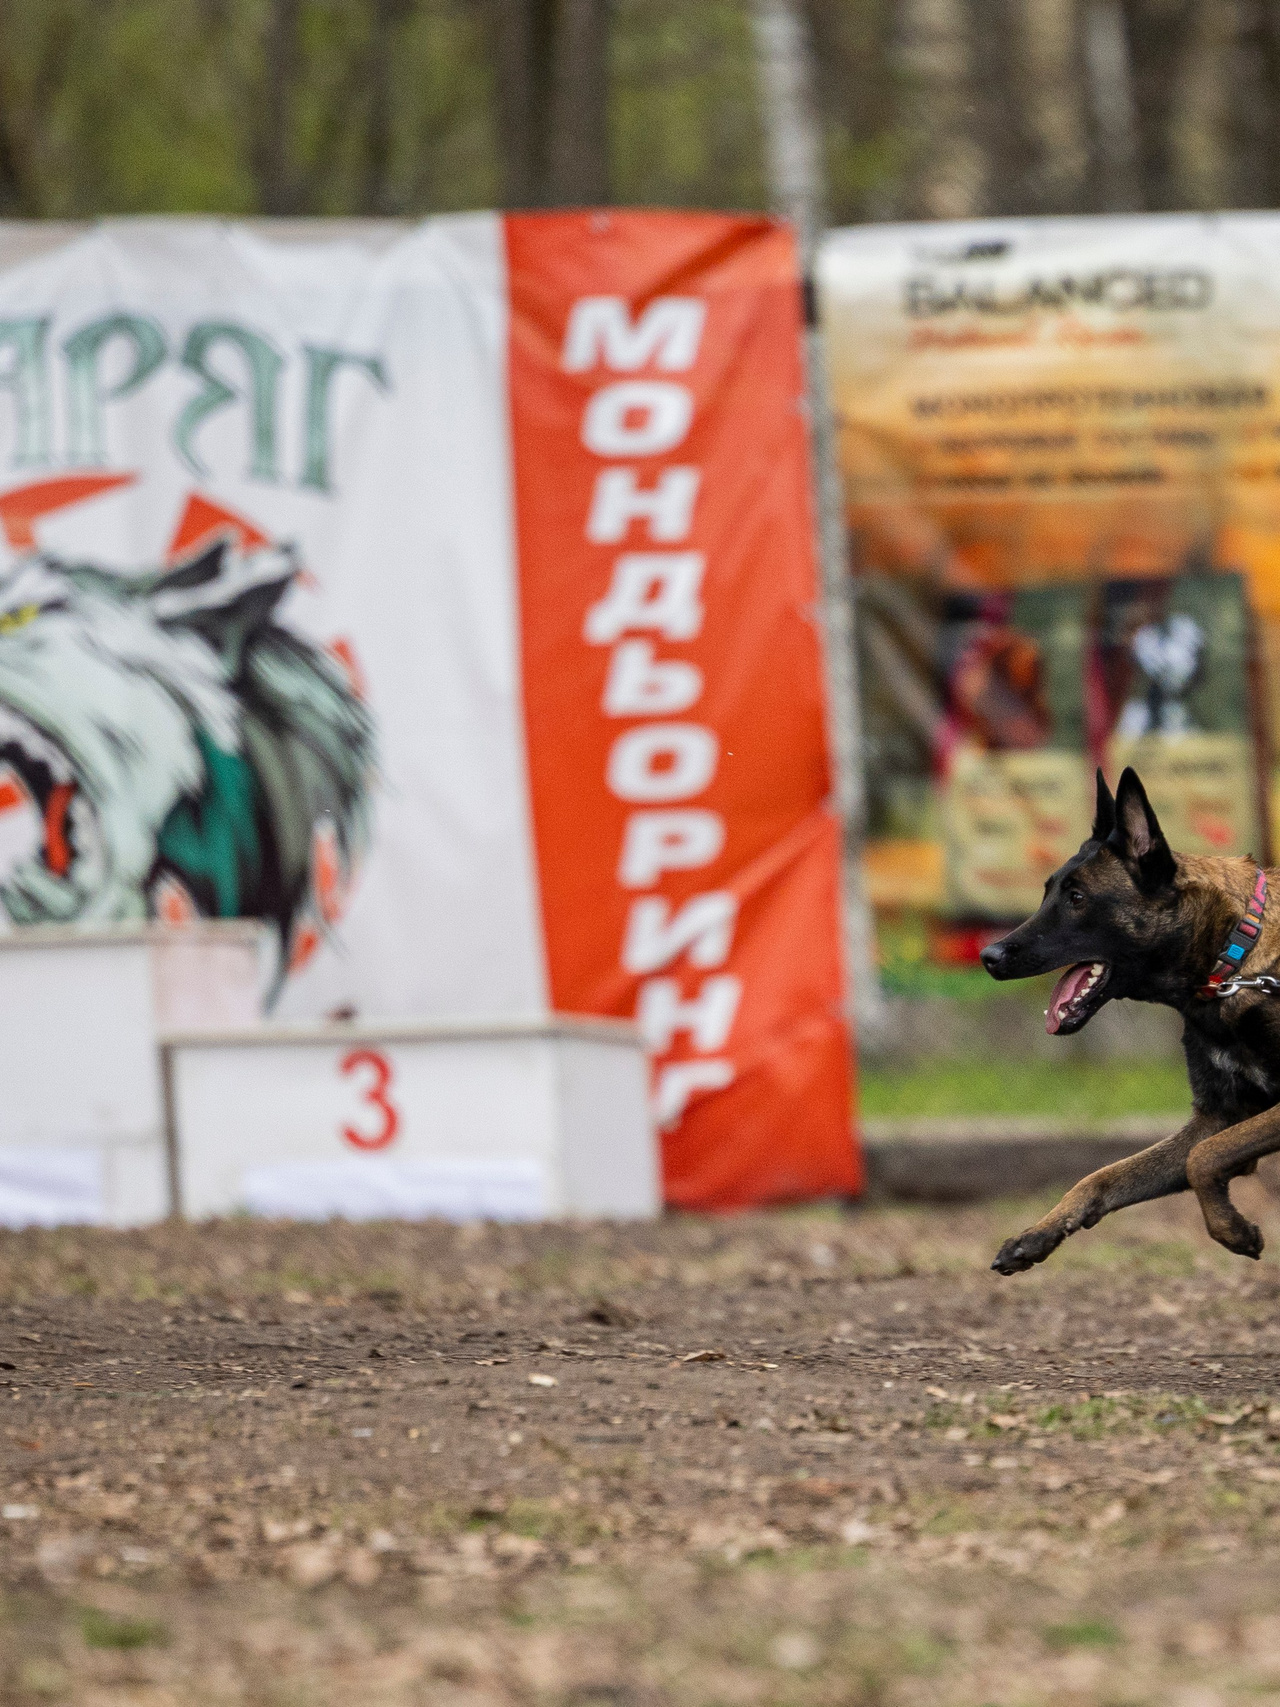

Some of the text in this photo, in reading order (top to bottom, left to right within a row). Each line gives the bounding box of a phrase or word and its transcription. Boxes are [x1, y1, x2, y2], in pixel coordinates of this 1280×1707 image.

[905, 268, 1215, 316] BALANCED
[560, 294, 744, 1132] МОНДЬОРИНГ
[339, 1046, 400, 1151] 3
